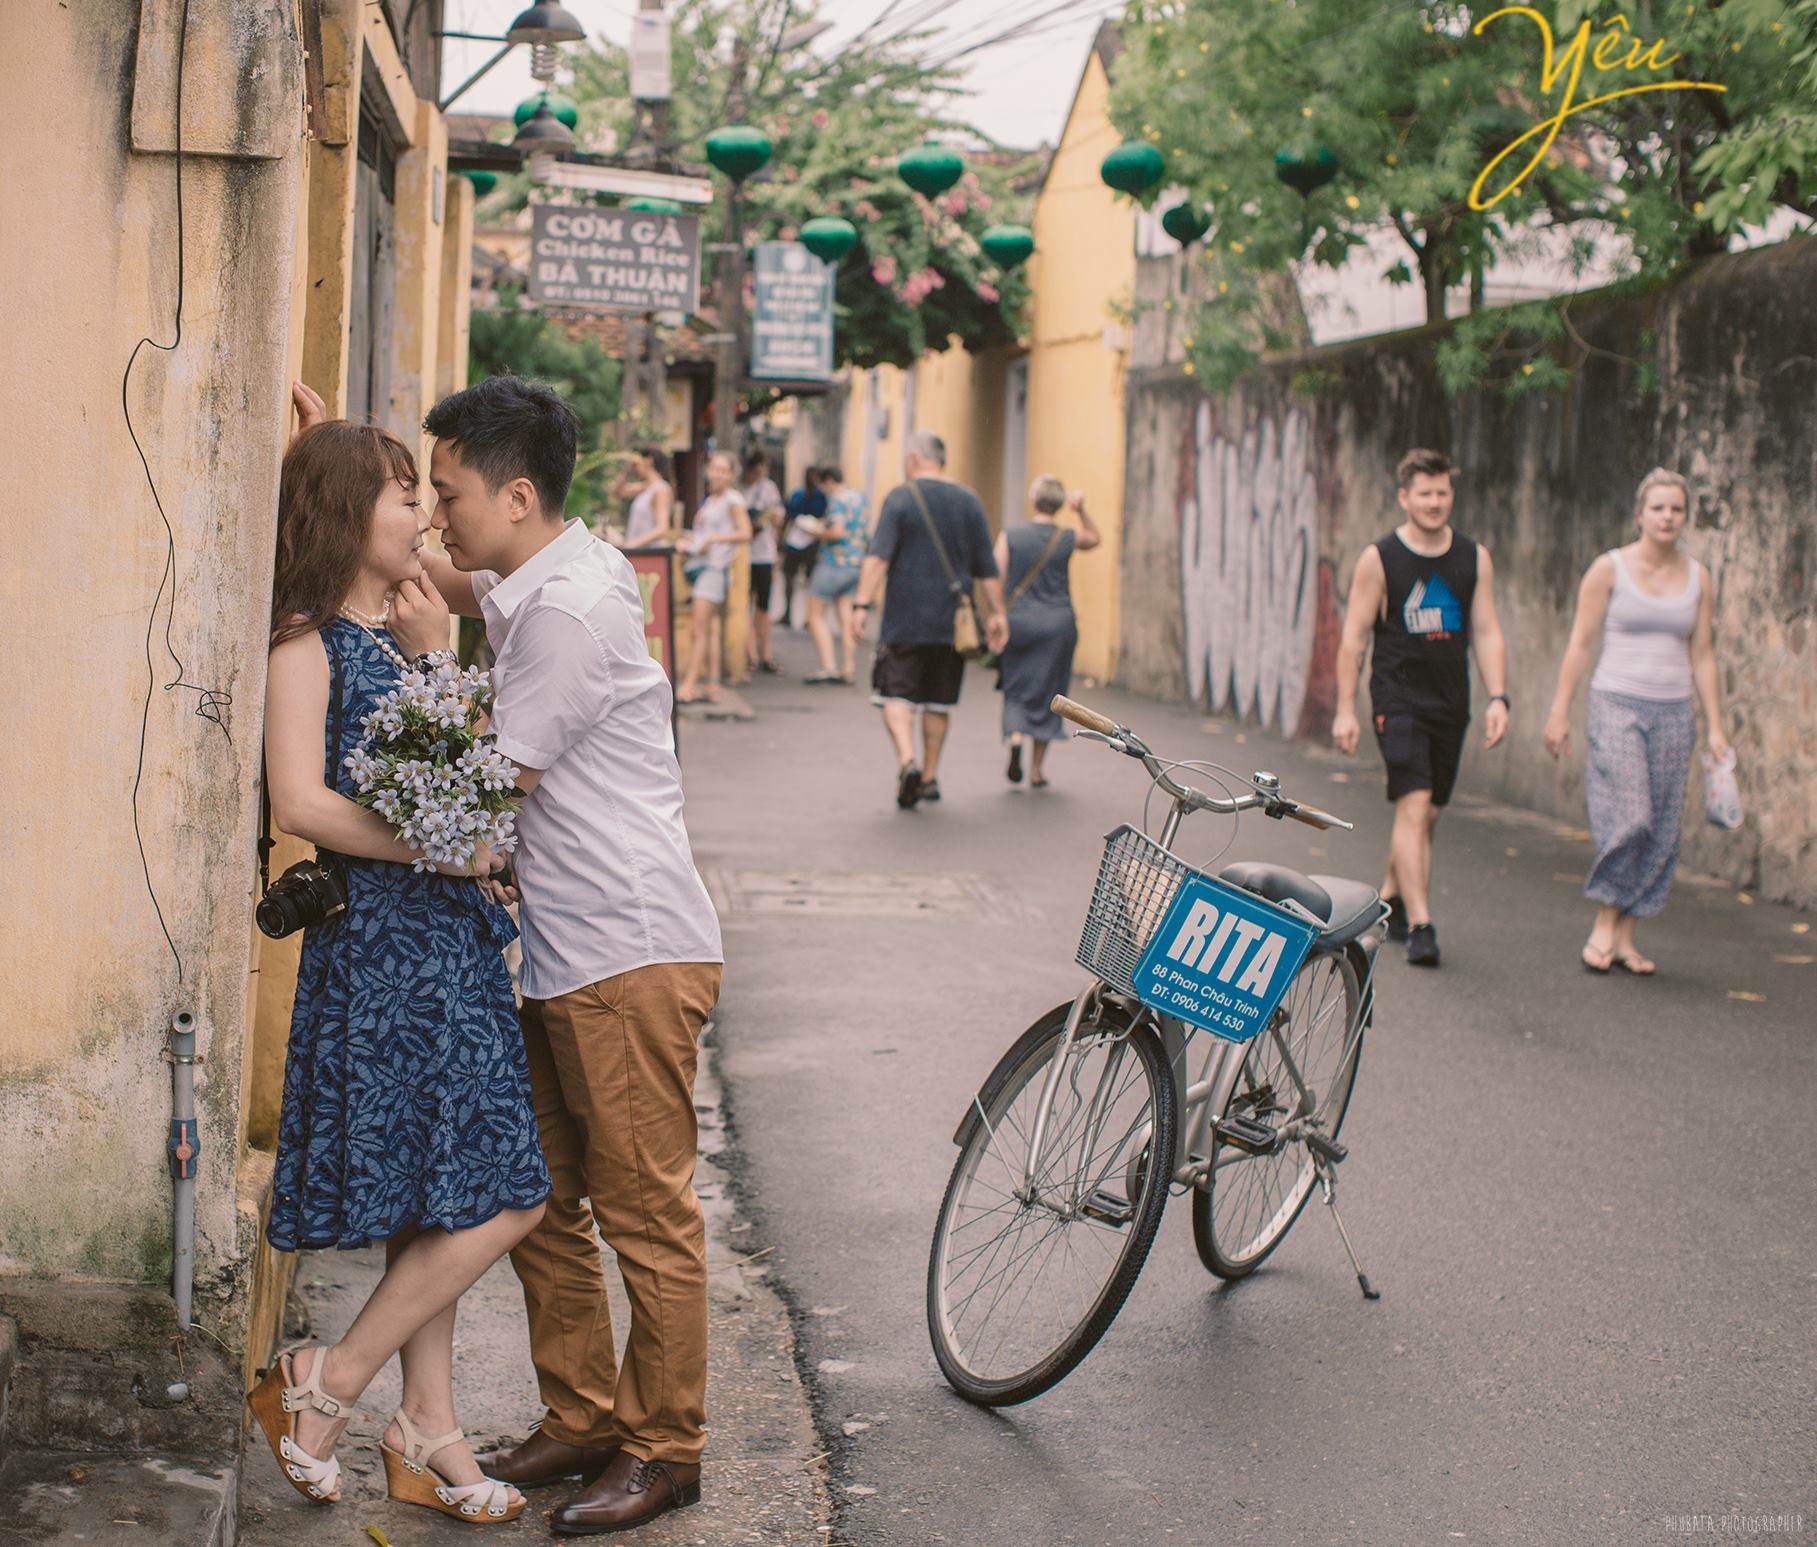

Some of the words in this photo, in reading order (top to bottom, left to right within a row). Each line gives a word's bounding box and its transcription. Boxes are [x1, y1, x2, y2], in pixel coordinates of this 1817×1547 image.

[546, 212, 624, 242] CƠM
[536, 238, 635, 262] Chicken
[640, 246, 690, 267] Rice
[1166, 898, 1287, 998] RITA
[1151, 983, 1170, 999] ĐT:
[1171, 992, 1199, 1012] 0906
[1200, 1005, 1222, 1022] 414
[1222, 1014, 1245, 1031] 530
[1152, 964, 1168, 978] 88
[1168, 971, 1199, 992] Phan
[1200, 985, 1233, 1007] Châu
[1234, 999, 1259, 1019] Trinh
